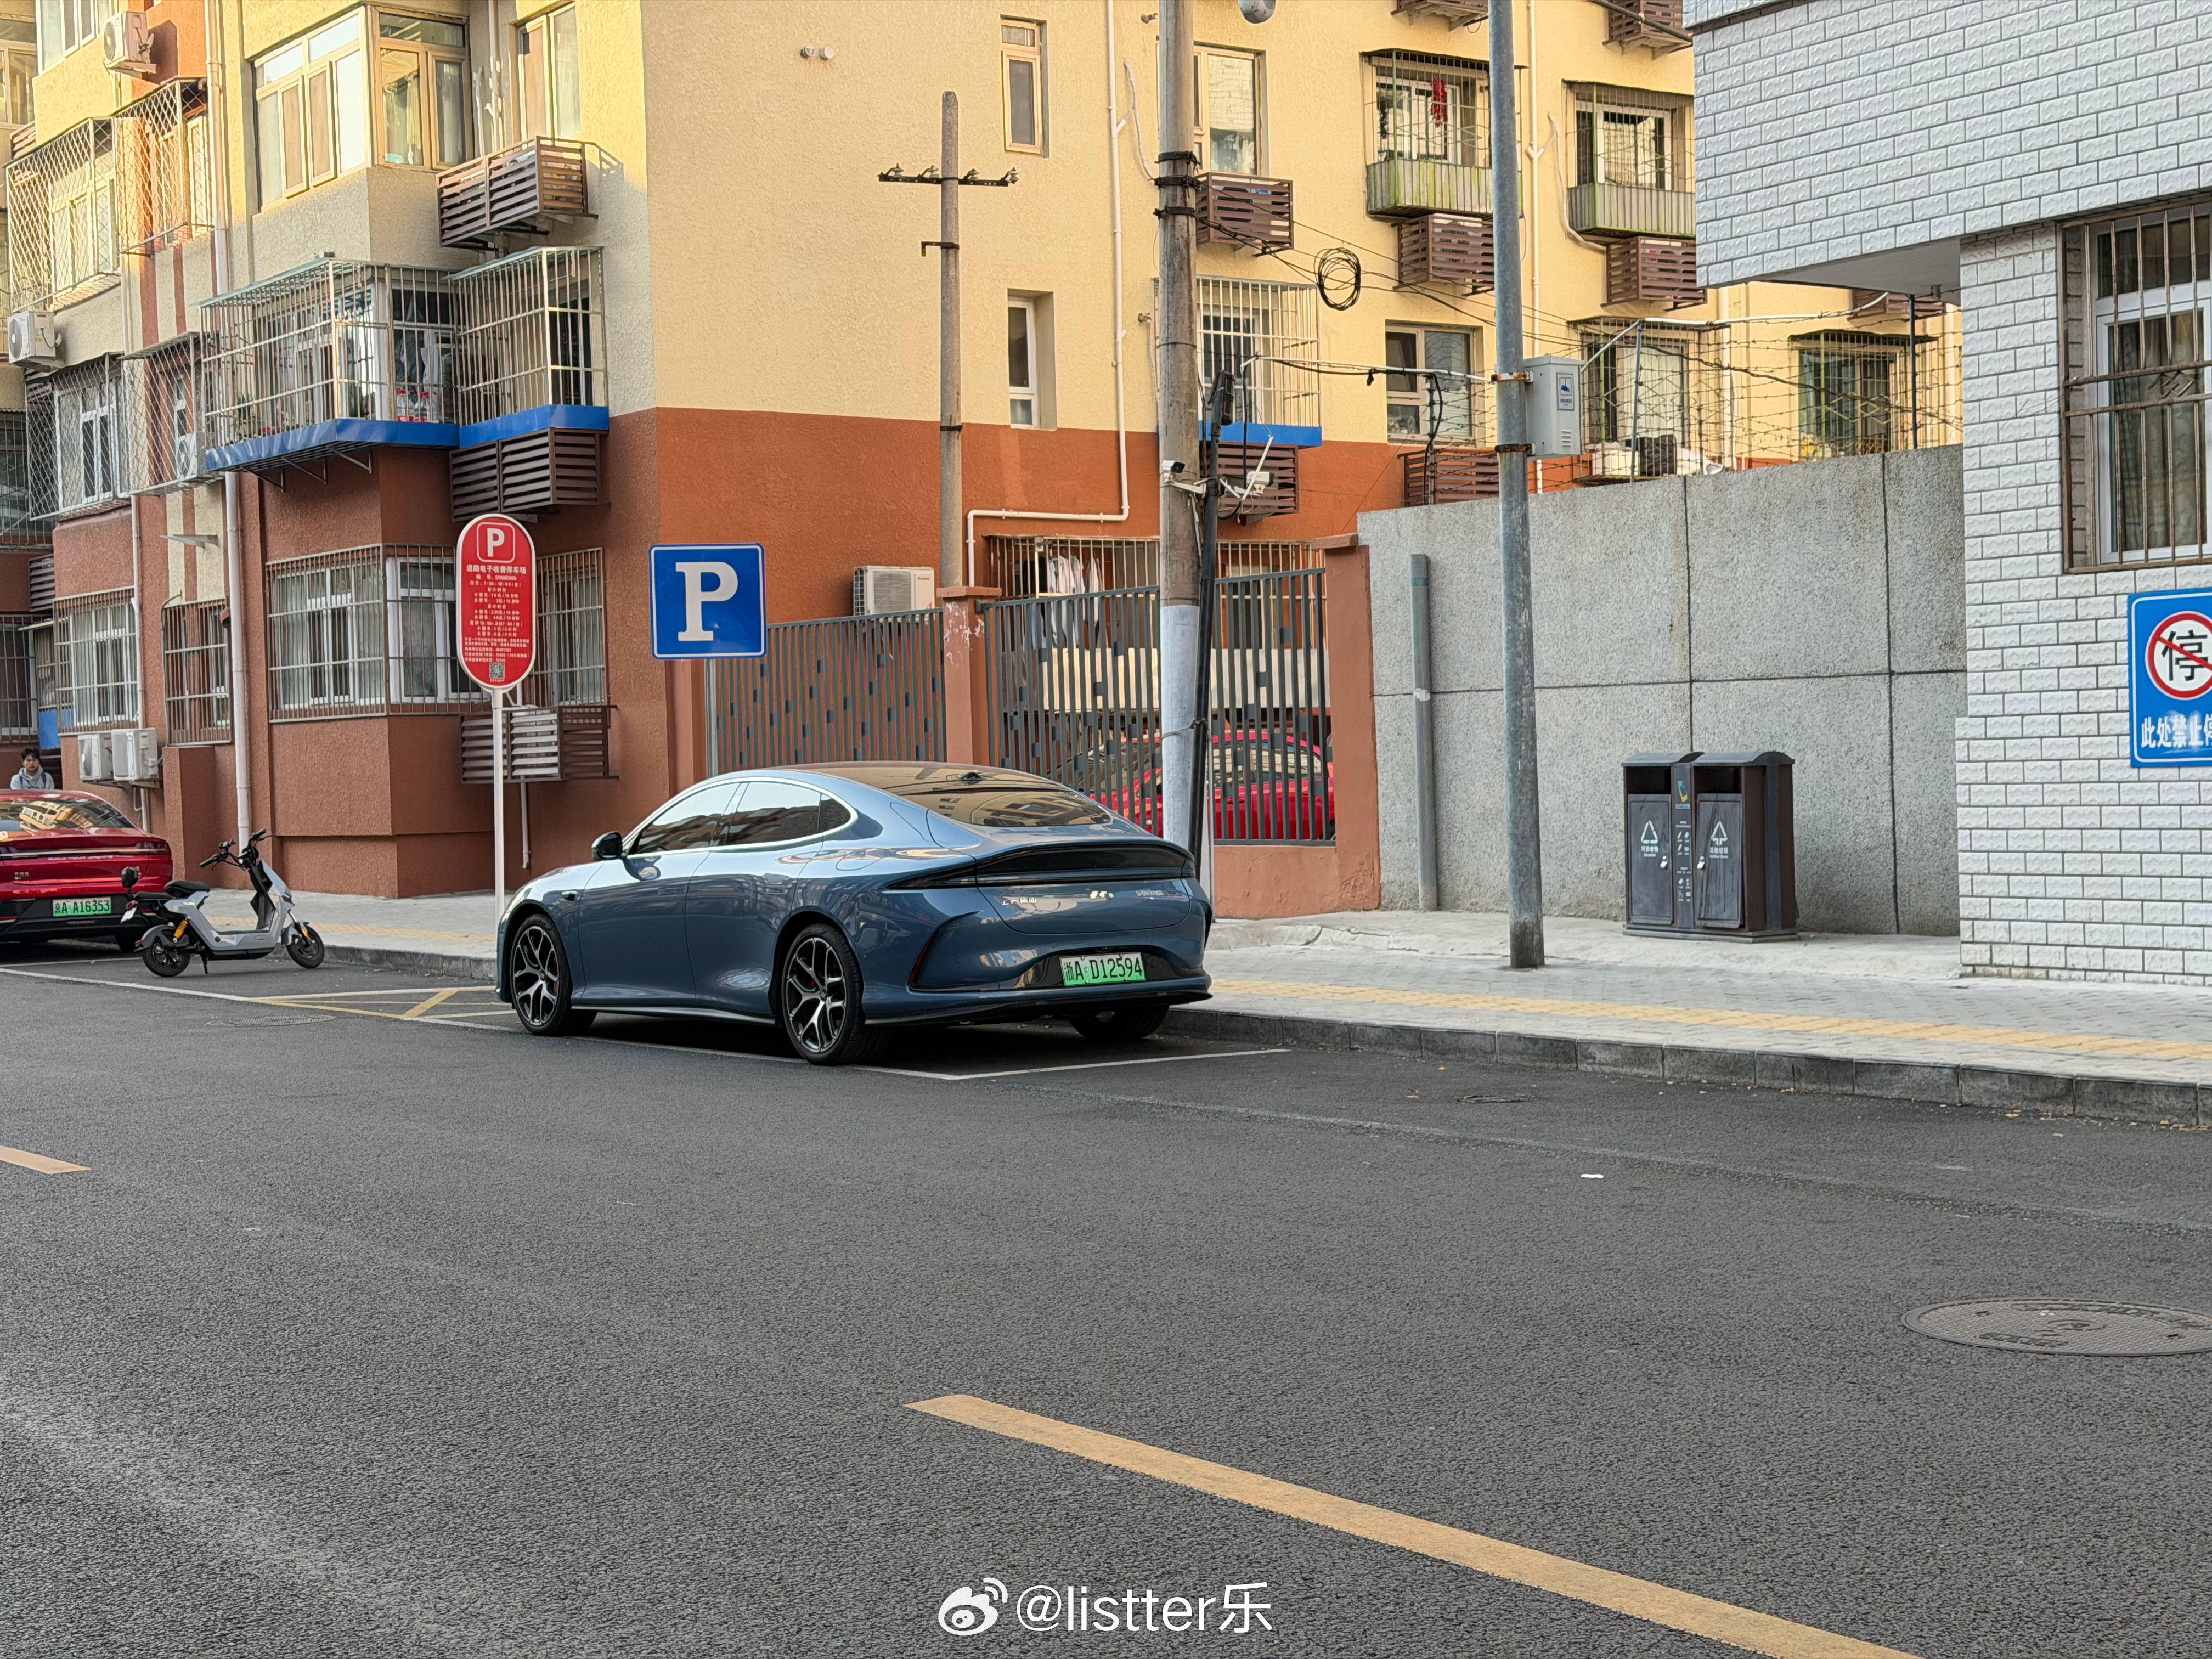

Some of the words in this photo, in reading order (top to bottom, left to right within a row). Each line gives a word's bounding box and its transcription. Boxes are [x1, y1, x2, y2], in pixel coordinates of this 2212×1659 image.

[487, 527, 505, 557] P
[675, 562, 738, 641] P
[2160, 629, 2209, 681] 停
